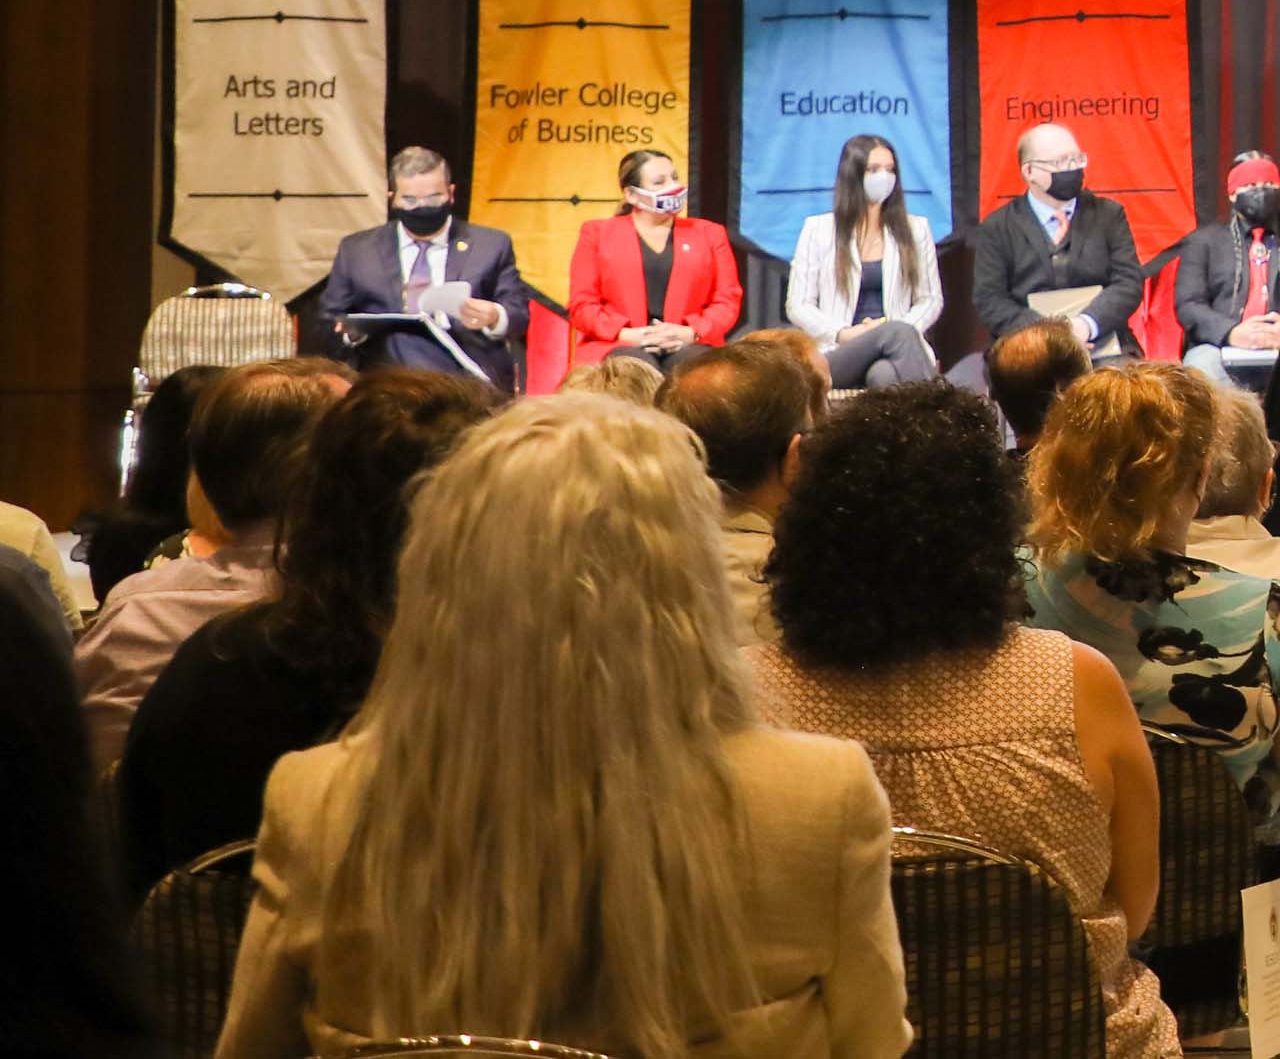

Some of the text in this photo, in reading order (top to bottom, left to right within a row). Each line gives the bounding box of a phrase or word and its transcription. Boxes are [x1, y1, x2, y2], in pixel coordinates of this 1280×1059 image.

[223, 75, 336, 100] Arts and
[489, 82, 678, 114] Fowler College
[780, 90, 909, 116] Education
[1005, 93, 1160, 124] Engineering
[233, 112, 324, 136] Letters
[508, 119, 654, 144] of Business
